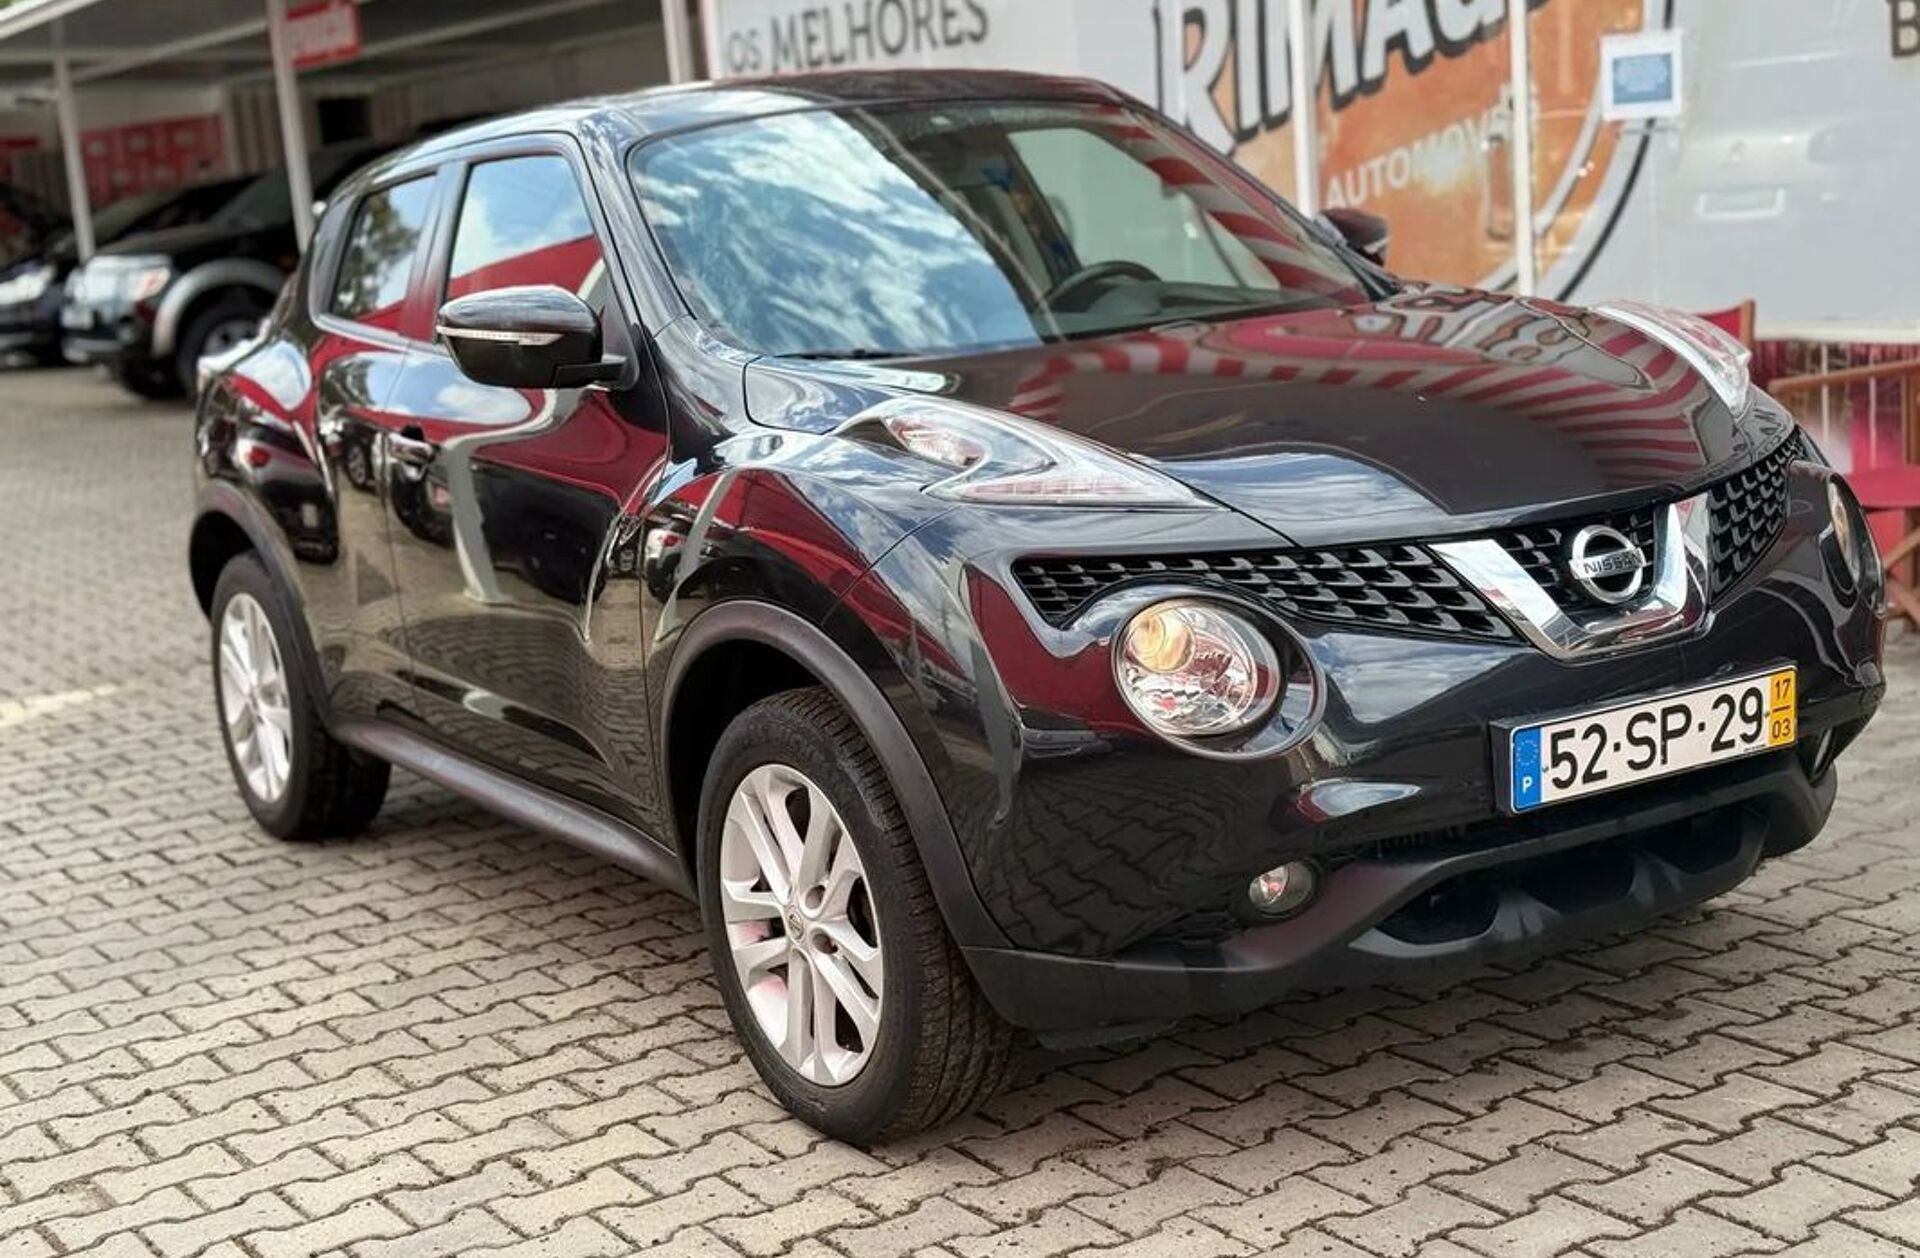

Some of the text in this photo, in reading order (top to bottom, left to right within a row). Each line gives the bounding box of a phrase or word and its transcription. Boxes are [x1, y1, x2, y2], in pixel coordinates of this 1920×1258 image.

[727, 0, 989, 73] OS MELHORES
[1326, 105, 1513, 210] AUTOMOV
[1582, 549, 1641, 575] NISSAN
[1774, 678, 1792, 700] 17
[1771, 717, 1792, 740] 03
[1522, 775, 1533, 794] P
